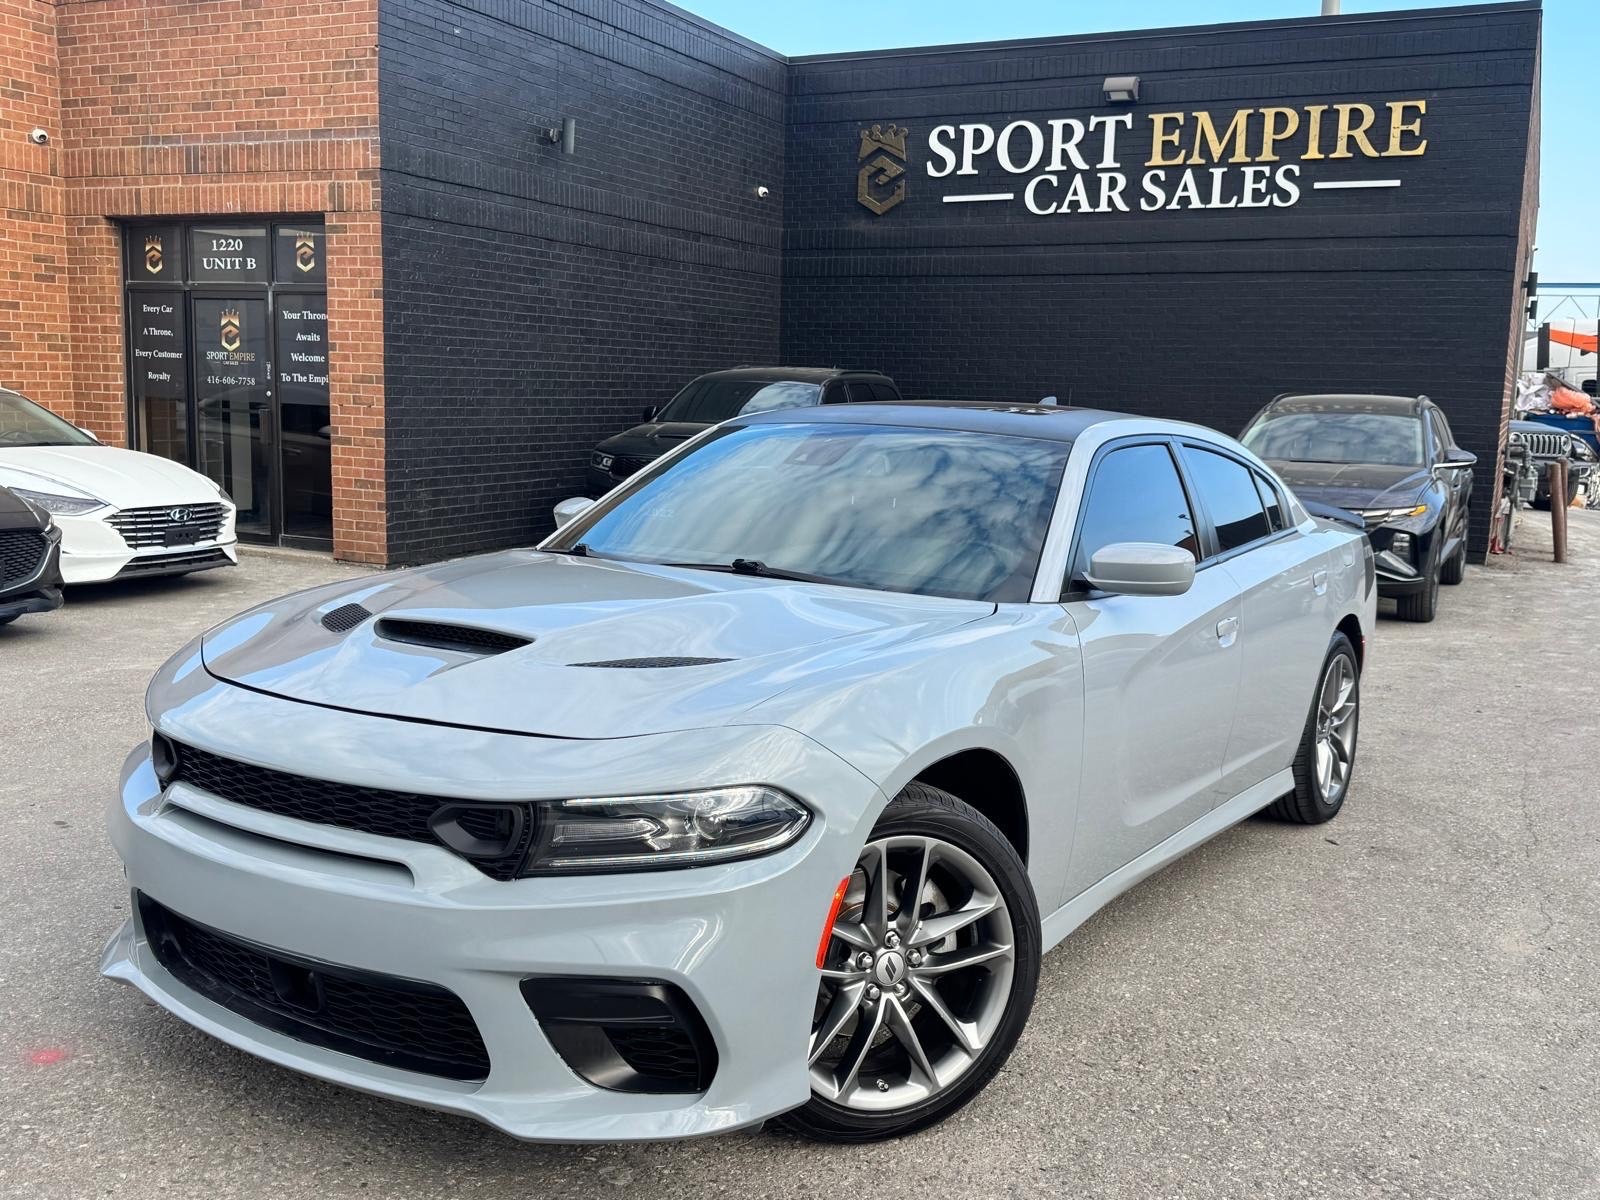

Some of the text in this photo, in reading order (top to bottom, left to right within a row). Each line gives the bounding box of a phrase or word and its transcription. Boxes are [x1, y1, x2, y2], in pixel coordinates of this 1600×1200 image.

[926, 99, 1428, 178] SPORT EMPIRE
[1024, 164, 1301, 215] CAR SALES
[211, 238, 244, 251] 1220
[202, 257, 257, 270] UNIT B
[143, 304, 173, 314] Every Car
[282, 310, 301, 320] Your
[143, 327, 174, 337] A Throne,
[295, 332, 321, 342] Awaits
[135, 349, 183, 359] Every Customer
[206, 351, 256, 361] SPORT EMPIRE
[290, 352, 326, 362] Welcome
[148, 371, 171, 382] Royalty
[207, 375, 256, 386] 416-606-7758
[280, 372, 291, 382] To
[292, 372, 308, 383] The
